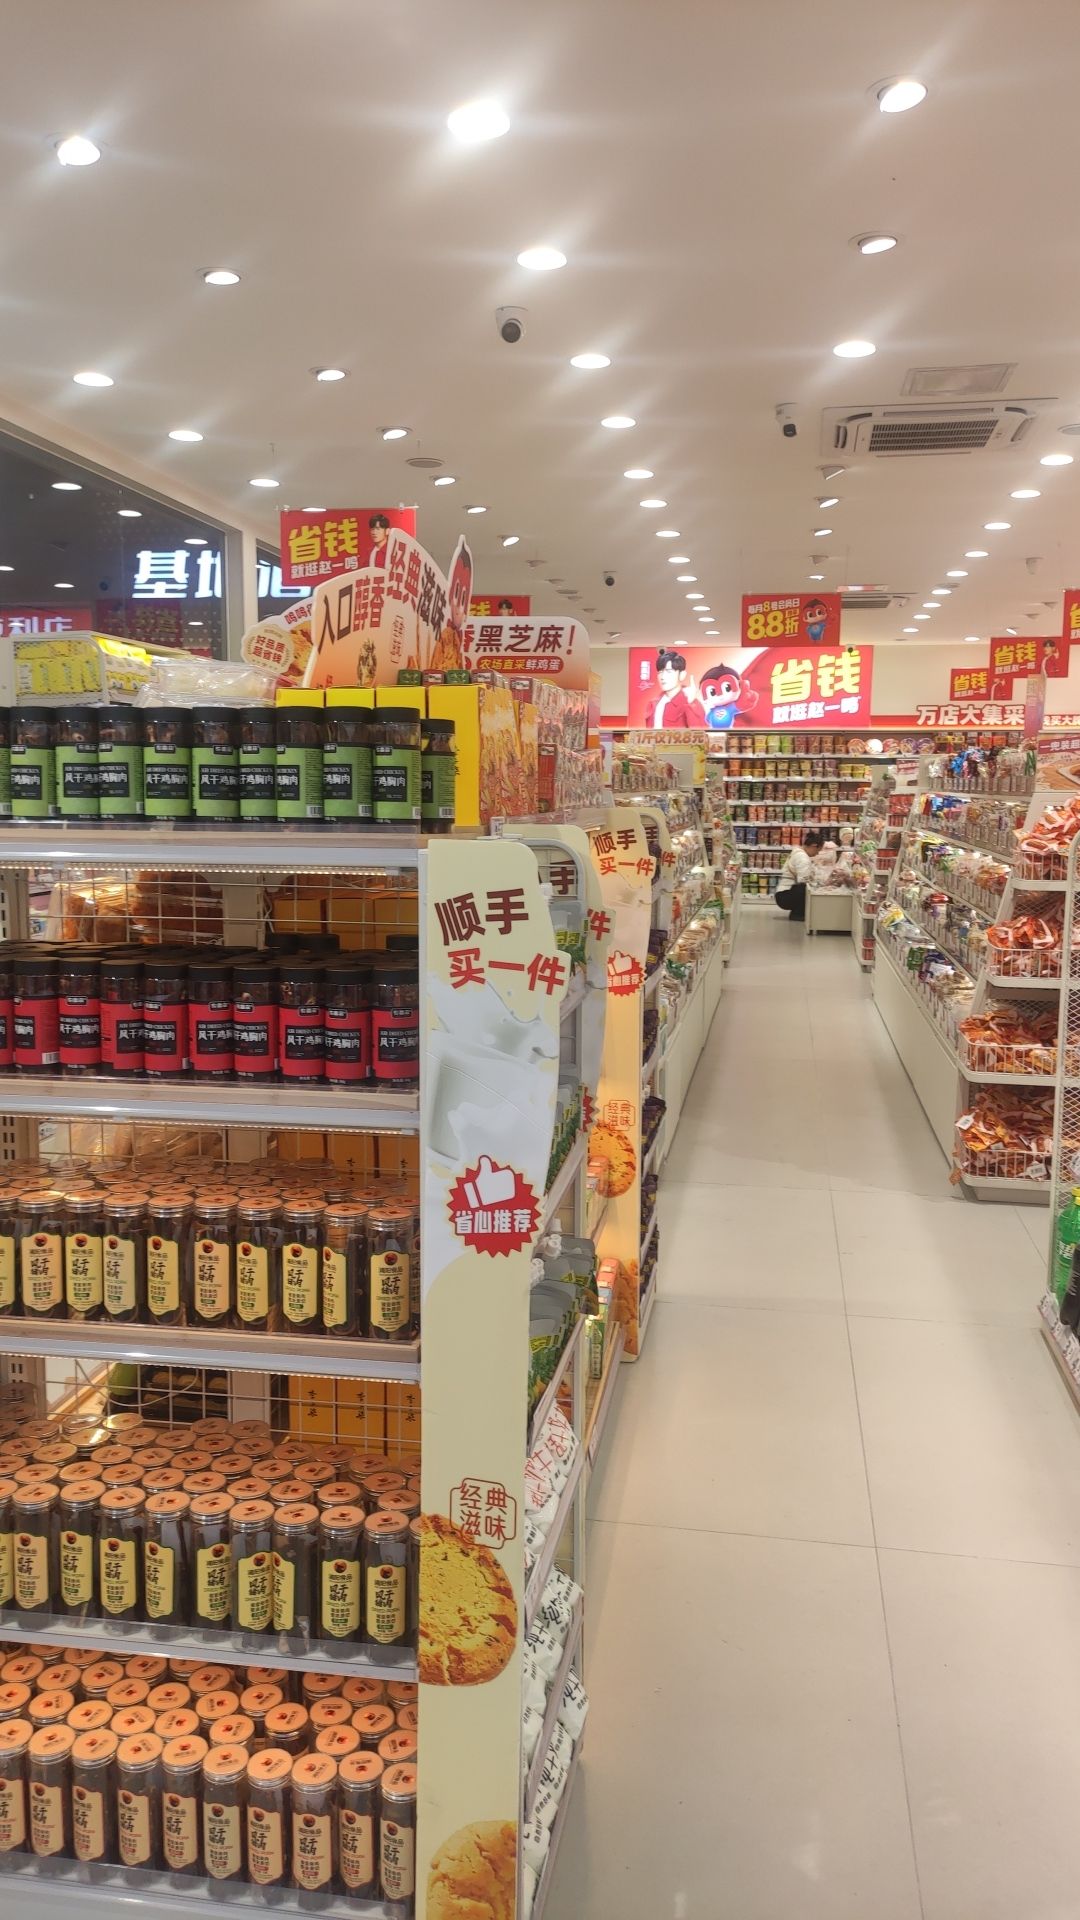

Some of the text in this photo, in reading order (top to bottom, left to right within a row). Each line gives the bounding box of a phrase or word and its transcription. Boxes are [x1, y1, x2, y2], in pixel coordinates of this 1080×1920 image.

[288, 518, 358, 563] 省钱
[291, 556, 358, 579] 就逛赵一鸣
[387, 539, 447, 641] 经典滋味
[318, 576, 385, 654] 入口醇香
[256, 635, 286, 654] 好品质
[995, 641, 1037, 666] 省钱
[480, 659, 562, 672] 农场直采鲜鸡蛋
[771, 651, 861, 704] 省钱
[954, 672, 987, 691] 省钱
[772, 696, 860, 724] 就逛赵一鸣
[917, 705, 1025, 725] 万店大集采
[593, 828, 637, 856] 顺手
[600, 856, 654, 877] 买一件
[434, 888, 529, 946] 顺手
[447, 948, 566, 995] 买一件
[454, 1208, 532, 1236] 省心推荐
[460, 1483, 507, 1515] 经典
[460, 1510, 507, 1541] 滋味
